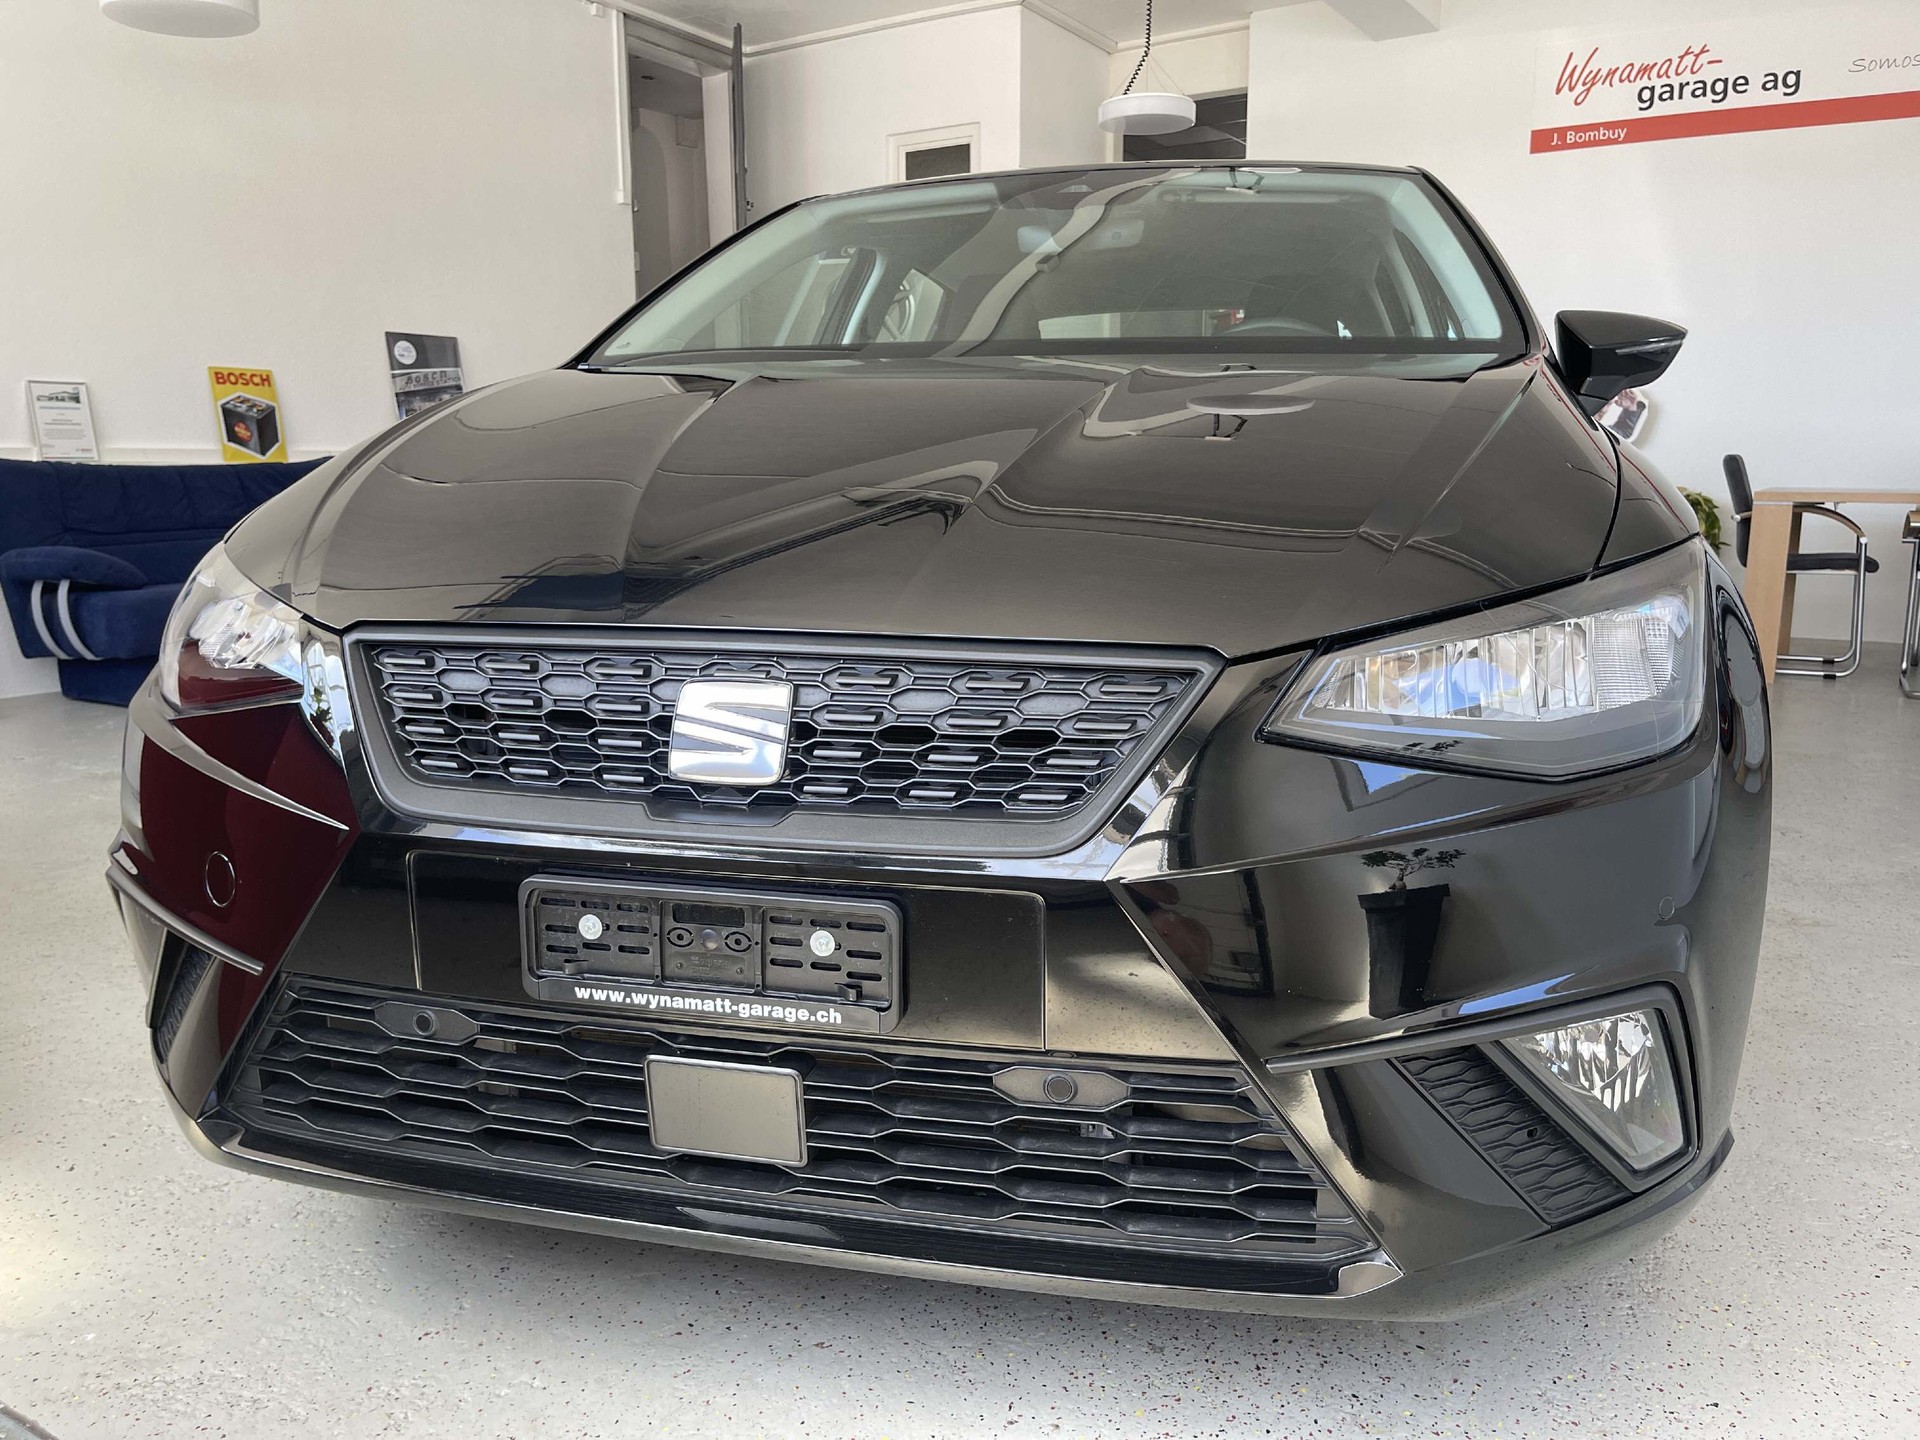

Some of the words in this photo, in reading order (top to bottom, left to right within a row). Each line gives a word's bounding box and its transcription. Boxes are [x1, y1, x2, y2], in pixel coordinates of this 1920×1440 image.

[1555, 43, 1723, 106] Wynamatt-
[1637, 72, 1749, 111] garage
[1761, 67, 1802, 96] ag
[1550, 130, 1562, 146] J.
[1566, 125, 1628, 145] Bombuy
[214, 370, 272, 388] BOSCH
[574, 986, 843, 1025] www.wynamatt-garage.ch
